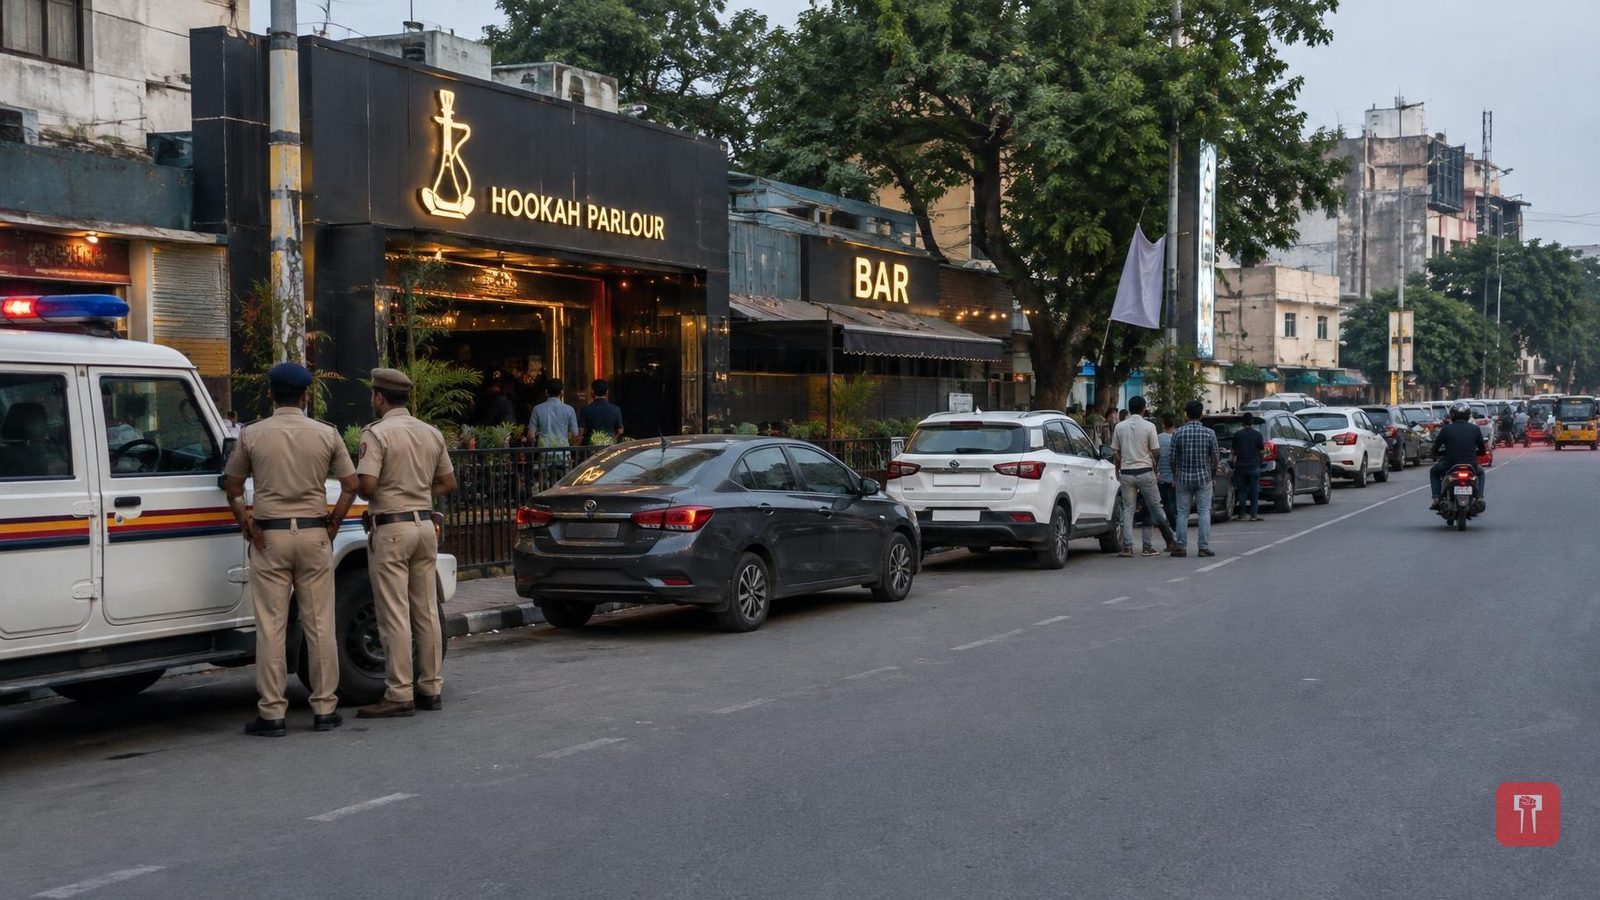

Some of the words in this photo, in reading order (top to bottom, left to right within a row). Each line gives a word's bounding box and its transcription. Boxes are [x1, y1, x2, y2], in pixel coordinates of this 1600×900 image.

[491, 186, 580, 227] HOOKAH
[587, 203, 665, 241] PARLOUR
[854, 256, 909, 304] BAR
